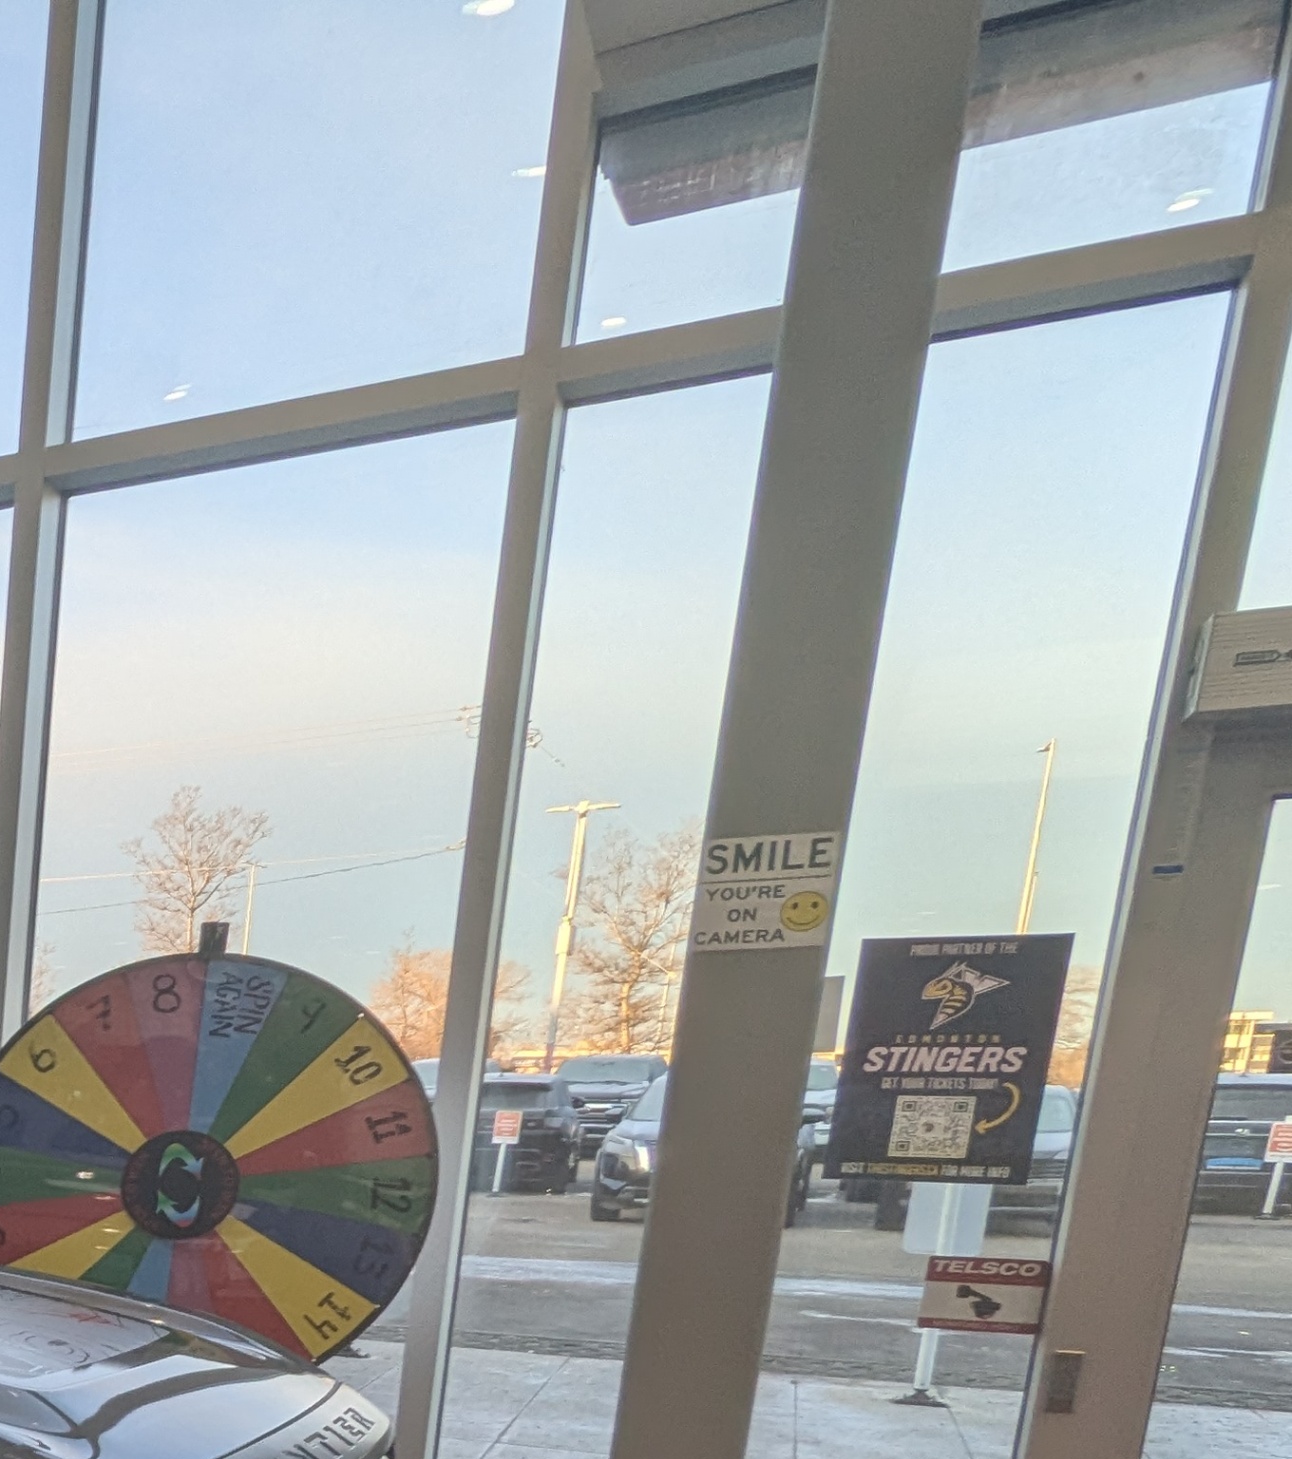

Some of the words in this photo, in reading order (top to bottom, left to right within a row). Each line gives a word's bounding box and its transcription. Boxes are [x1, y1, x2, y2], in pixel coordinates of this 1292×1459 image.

[706, 836, 834, 875] SMILE
[706, 884, 786, 901] YOU'RE
[726, 907, 757, 922] ON
[693, 928, 785, 945] CAMERA
[152, 974, 181, 1014] 8
[209, 971, 244, 1038] AGAIN
[232, 975, 274, 1036] SPIN
[28, 1040, 57, 1074] 6
[334, 1045, 384, 1086] 10
[863, 1046, 1028, 1073] STINGERS
[365, 1111, 413, 1144] 11
[370, 1178, 413, 1213] 12
[934, 1259, 1042, 1277] TELSCO
[302, 1291, 352, 1341] 14
